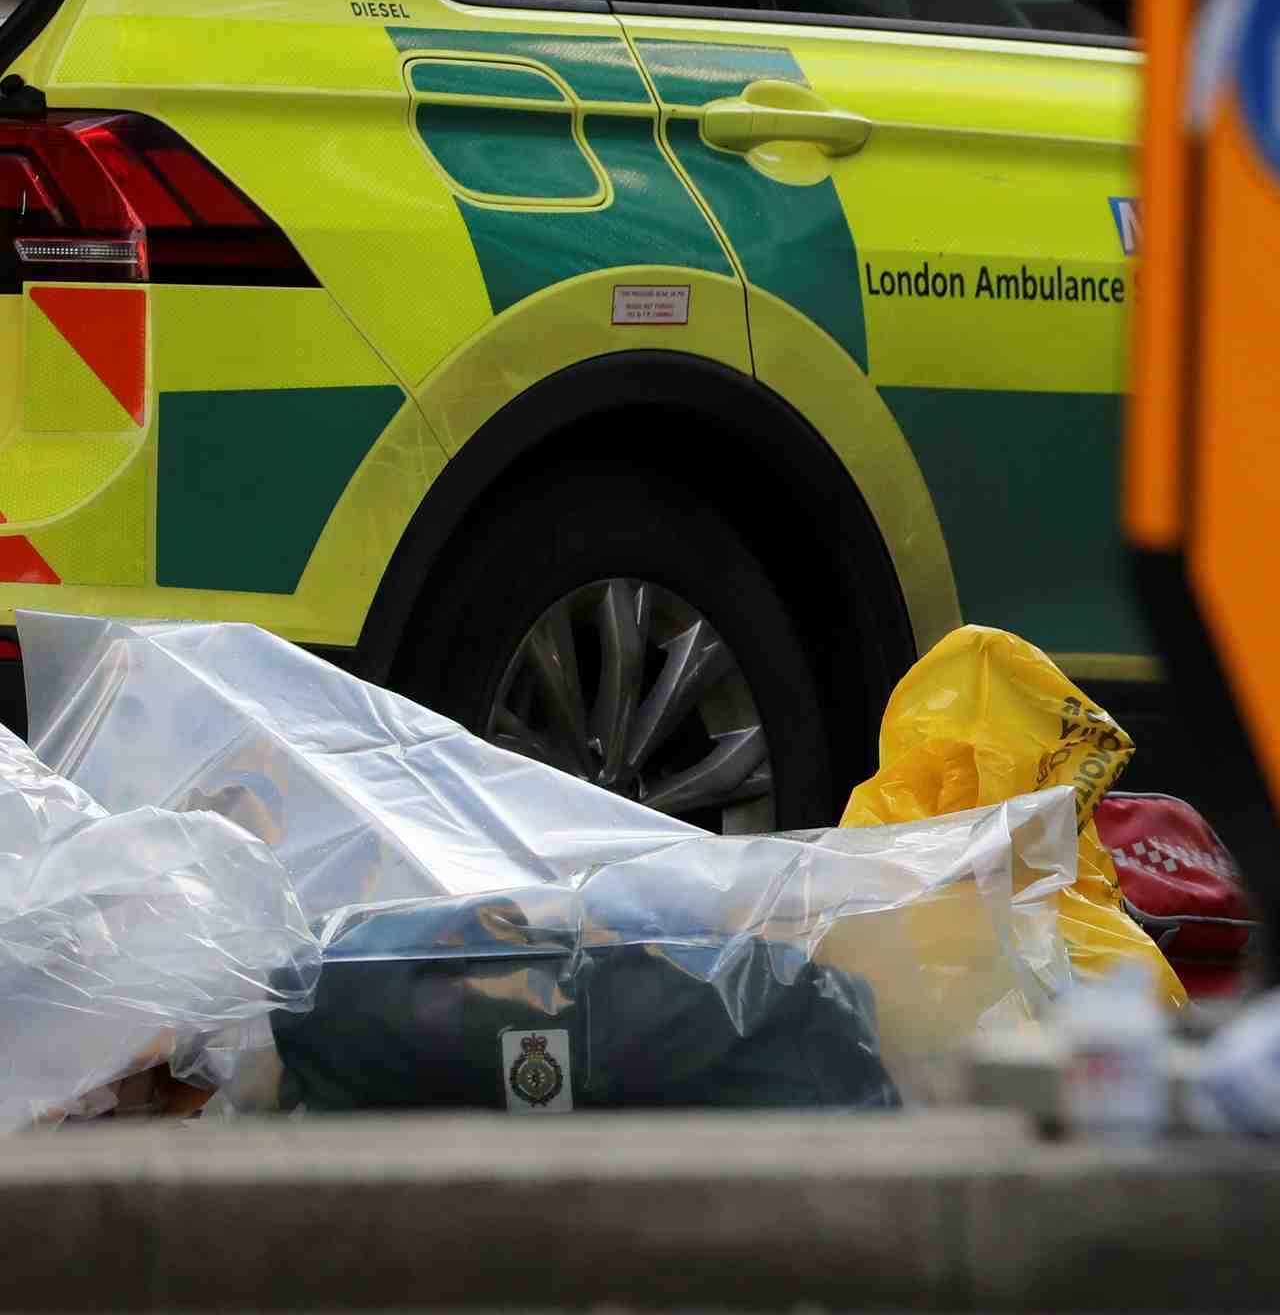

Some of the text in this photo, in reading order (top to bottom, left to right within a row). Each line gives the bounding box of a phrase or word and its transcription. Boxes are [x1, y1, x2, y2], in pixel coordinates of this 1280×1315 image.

[351, 2, 410, 19] DIESEL
[865, 262, 965, 298] London
[975, 264, 1125, 303] Ambulance
